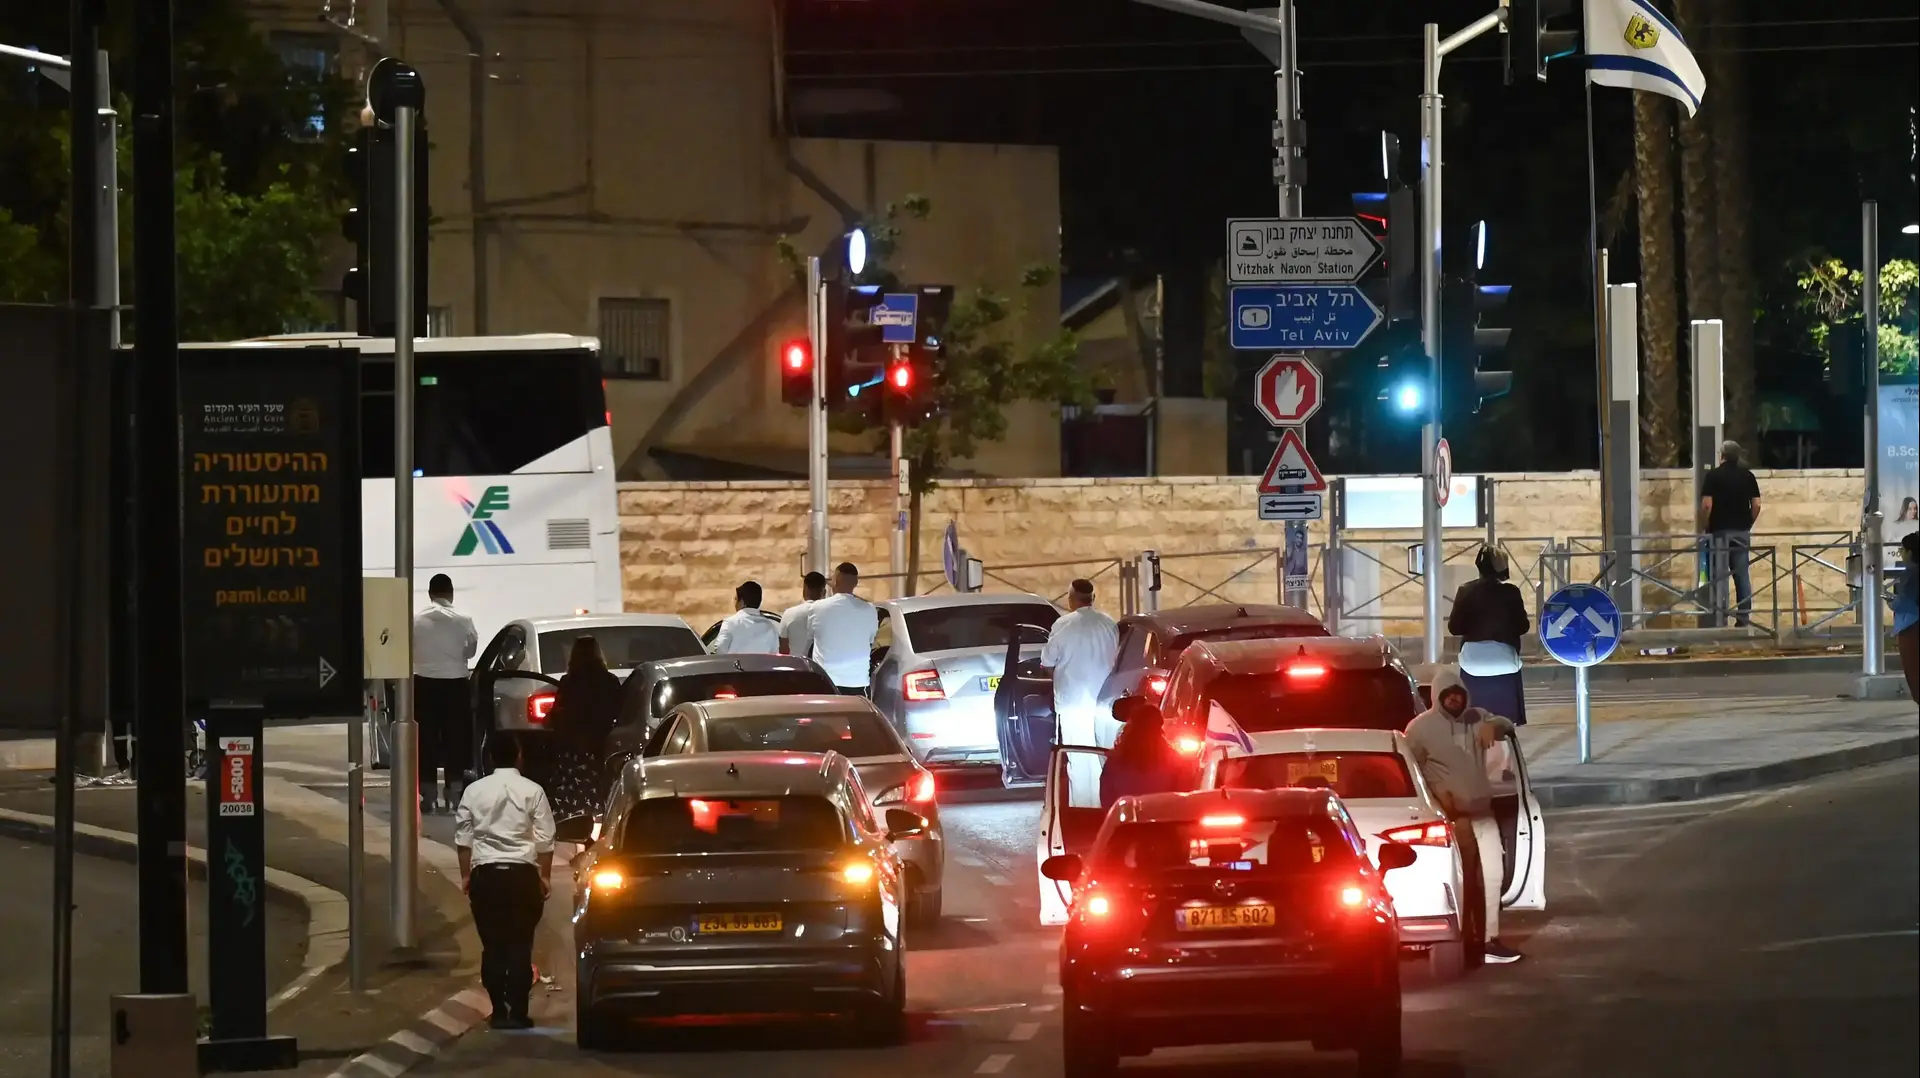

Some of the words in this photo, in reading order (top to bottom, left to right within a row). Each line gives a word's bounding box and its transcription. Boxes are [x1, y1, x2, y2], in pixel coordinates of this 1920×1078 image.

[1266, 227, 1285, 244] נבון
[1289, 226, 1317, 244] יצחק
[1322, 226, 1353, 240] תחנת
[1324, 246, 1353, 256] محطة
[1236, 263, 1275, 275] Yitzhak
[1280, 263, 1312, 274] Navon
[1317, 262, 1354, 274] Station
[1275, 293, 1318, 307] אביב
[1327, 289, 1354, 307] תל
[1251, 312, 1258, 323] 1
[1293, 309, 1315, 324] أبيب
[1323, 312, 1336, 325] تل
[1280, 329, 1304, 341] Tel
[1313, 328, 1350, 341] Aviv
[193, 452, 328, 473] ההיסטוריה
[200, 484, 320, 504] מתעוררת
[226, 510, 297, 536] לחיים
[204, 543, 320, 567] בירושלים
[216, 586, 307, 607] pami.co.il
[222, 804, 252, 813] 20038
